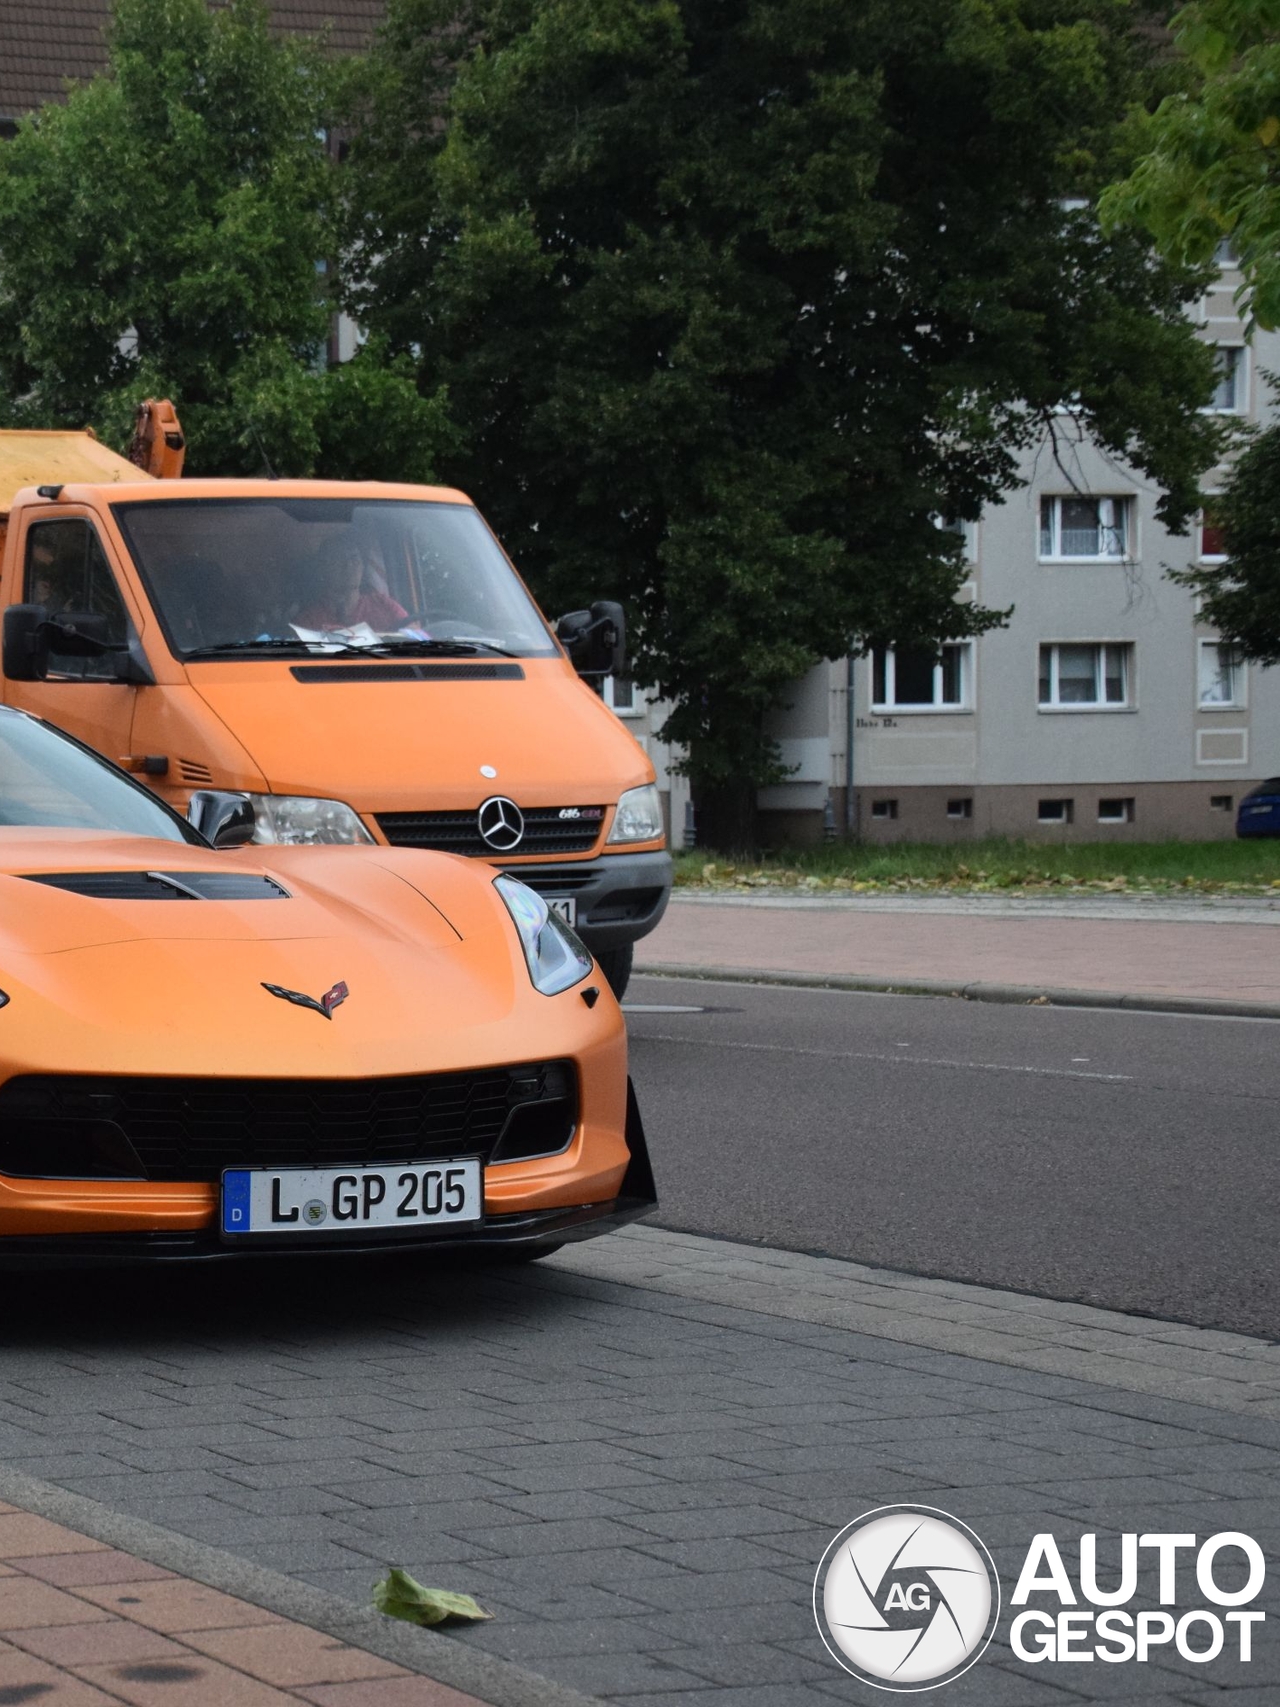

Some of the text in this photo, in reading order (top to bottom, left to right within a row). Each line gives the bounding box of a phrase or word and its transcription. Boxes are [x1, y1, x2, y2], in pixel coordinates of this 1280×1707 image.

[559, 808, 580, 819] 616
[552, 901, 572, 924] 1
[272, 1169, 465, 1223] L GP 205
[231, 1208, 243, 1222] D
